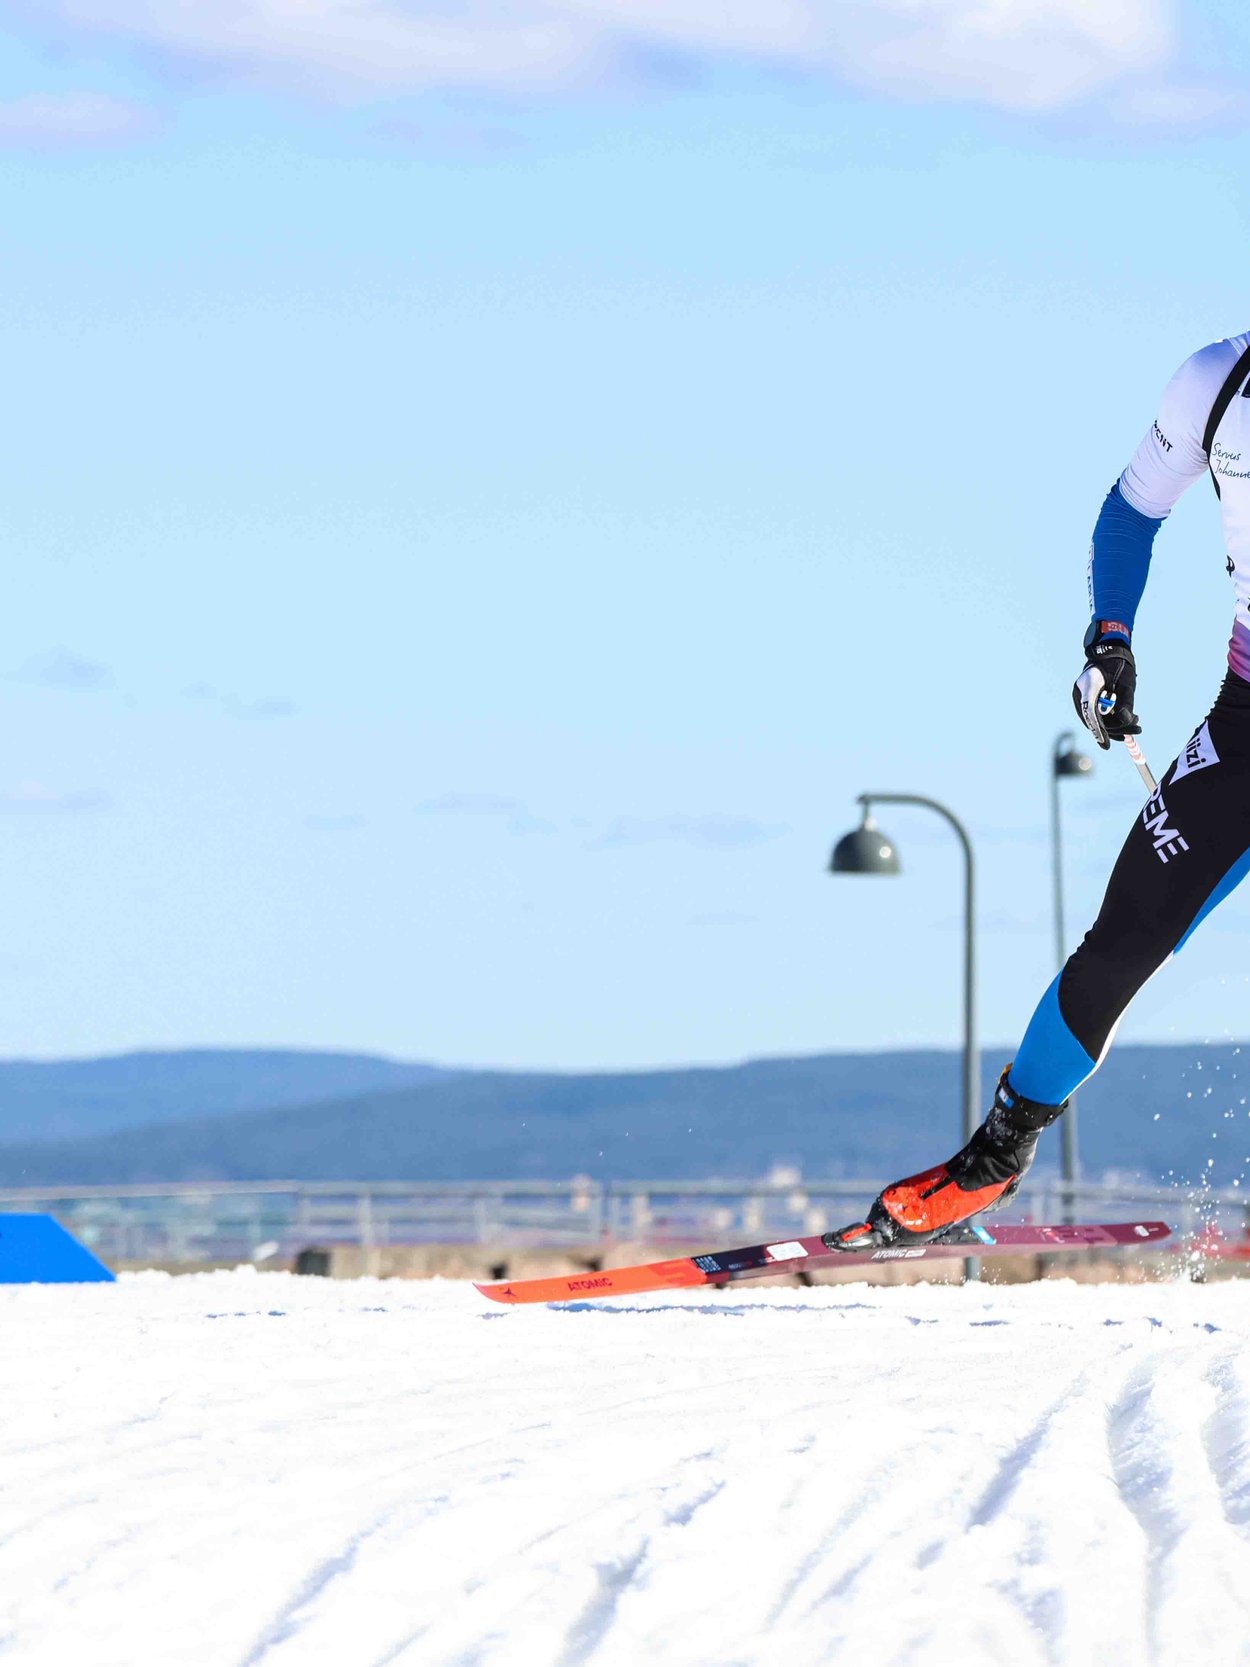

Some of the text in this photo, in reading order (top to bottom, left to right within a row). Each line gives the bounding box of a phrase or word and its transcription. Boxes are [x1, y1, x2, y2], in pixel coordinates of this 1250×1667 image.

[1212, 442, 1241, 461] Servus
[871, 1248, 906, 1260] ATOMIC
[567, 1277, 613, 1292] ATOMIC
